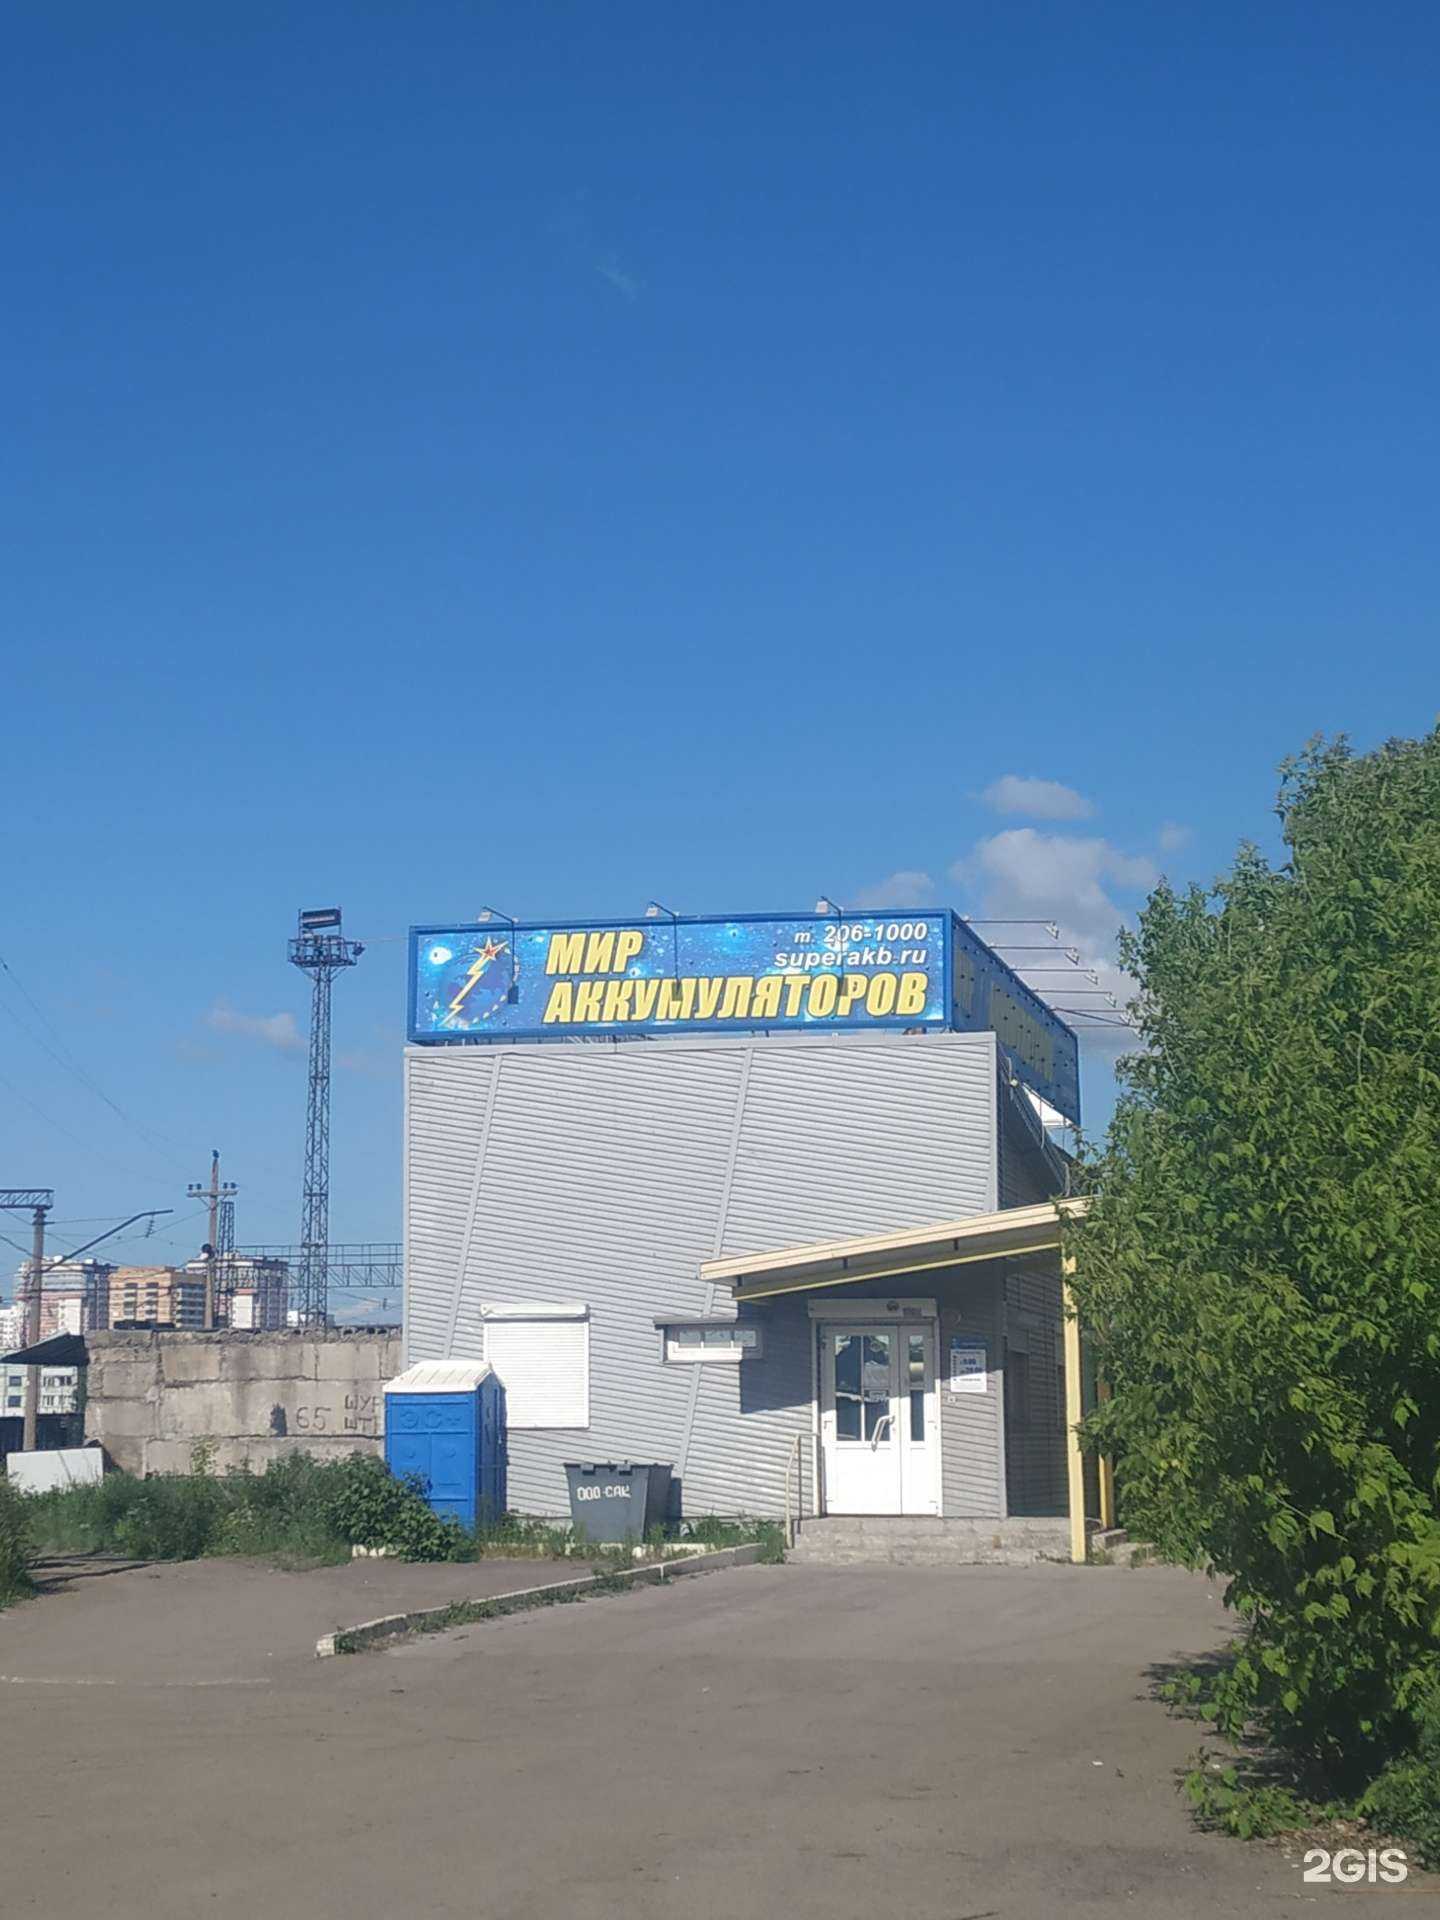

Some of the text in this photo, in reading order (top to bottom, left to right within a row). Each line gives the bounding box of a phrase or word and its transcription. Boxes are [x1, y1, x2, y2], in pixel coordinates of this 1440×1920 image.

[823, 922, 928, 943] 206-1000
[545, 931, 644, 975] МИР
[774, 947, 927, 970] superakb.ru
[542, 971, 929, 1024] АККУМУЛЯТОРОВ
[295, 1406, 332, 1431] 65
